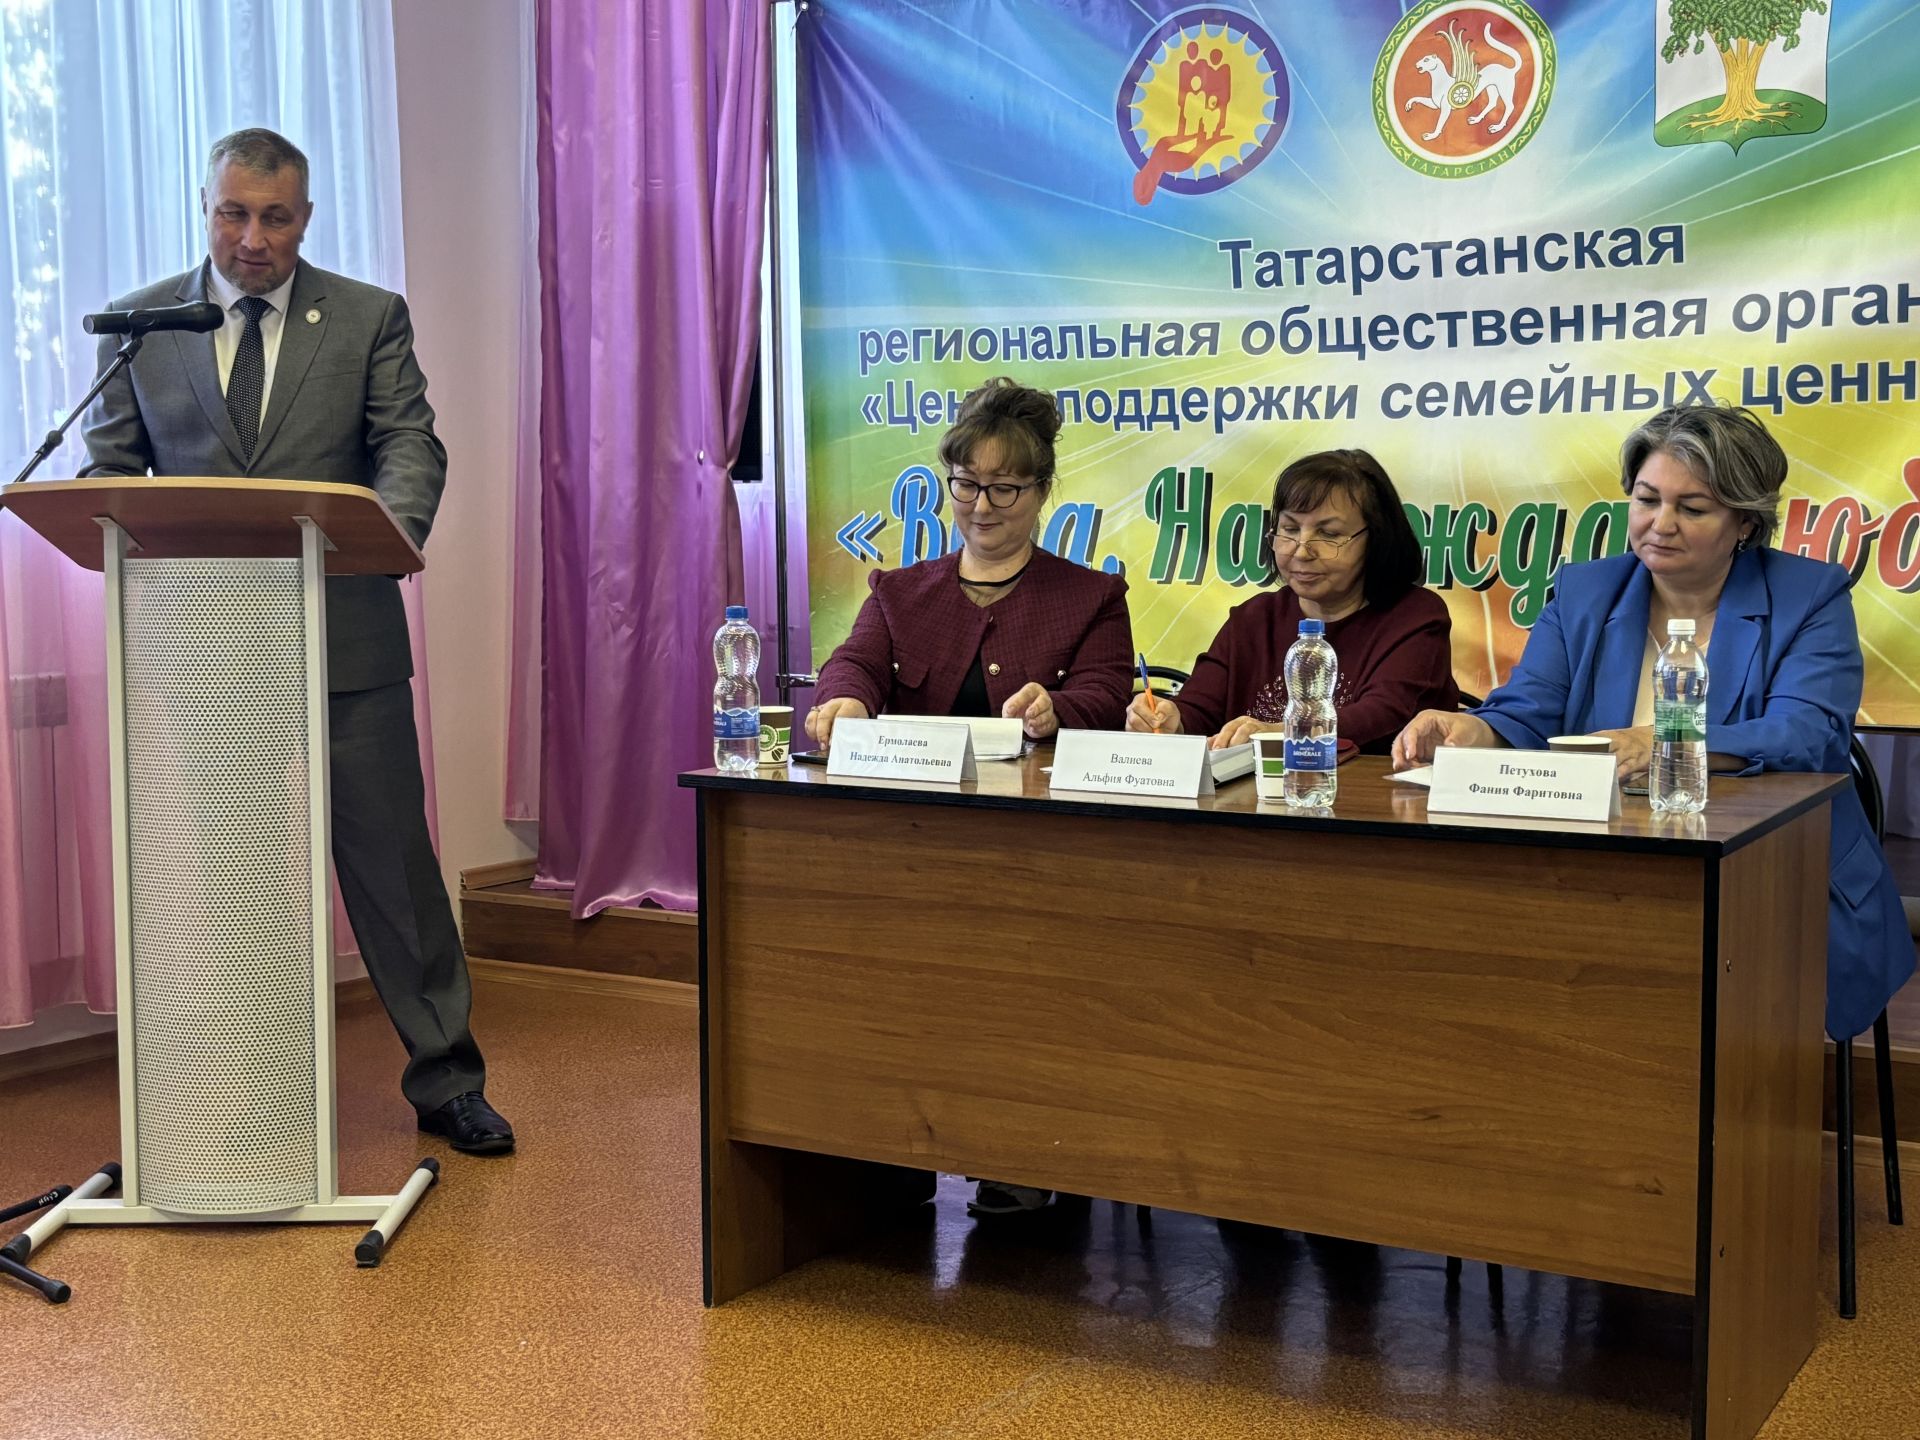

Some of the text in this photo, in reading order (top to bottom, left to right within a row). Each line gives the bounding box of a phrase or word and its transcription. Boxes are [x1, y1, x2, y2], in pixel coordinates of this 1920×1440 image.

[1411, 150, 1511, 177] ТАТАРСТАН
[1218, 223, 1686, 296] Татарстанская
[858, 320, 1221, 375] региональная
[1241, 297, 1708, 360] общественная
[1055, 382, 1357, 434] поддержки
[1380, 362, 1718, 419] семейных
[1741, 360, 1917, 415] ценн
[878, 735, 928, 747] Ермолаева
[850, 751, 952, 767] Надежда Анатольевна
[1110, 753, 1153, 766] Валиева
[1082, 771, 1175, 787] Альфия Фуатовна
[1499, 764, 1557, 778] Петухова
[1469, 783, 1582, 800] Фания Фаритовна
